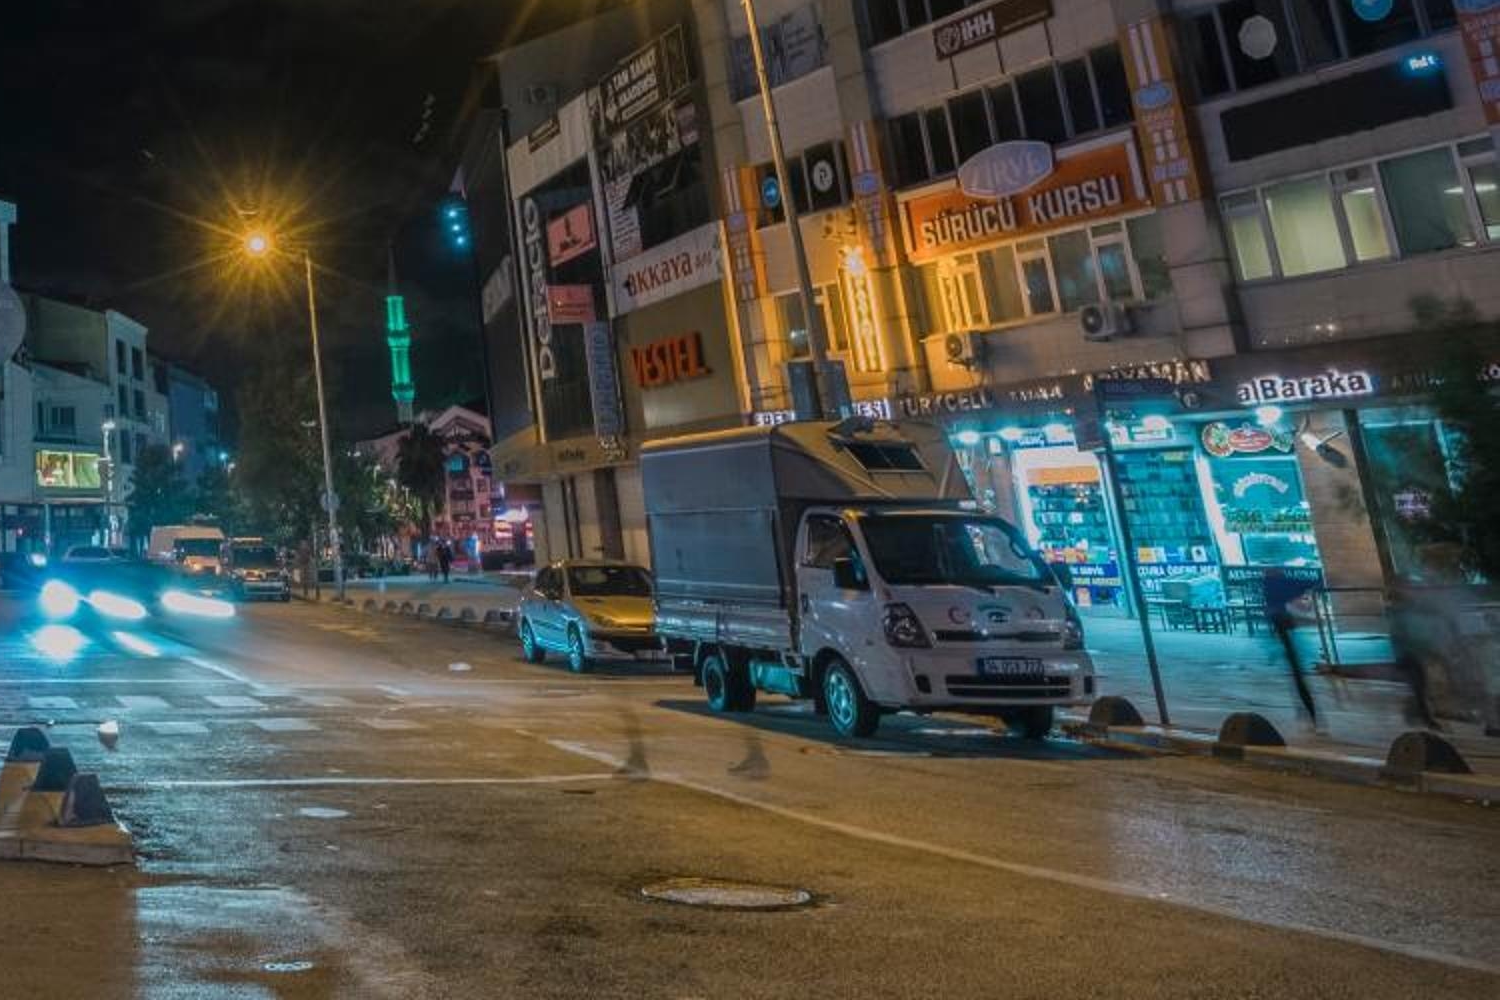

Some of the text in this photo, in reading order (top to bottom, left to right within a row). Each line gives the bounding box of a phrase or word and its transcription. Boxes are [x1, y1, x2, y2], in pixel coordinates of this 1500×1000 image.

[921, 174, 1122, 250] SÜRÜCÜ KURSU
[629, 329, 714, 389] VESTEL
